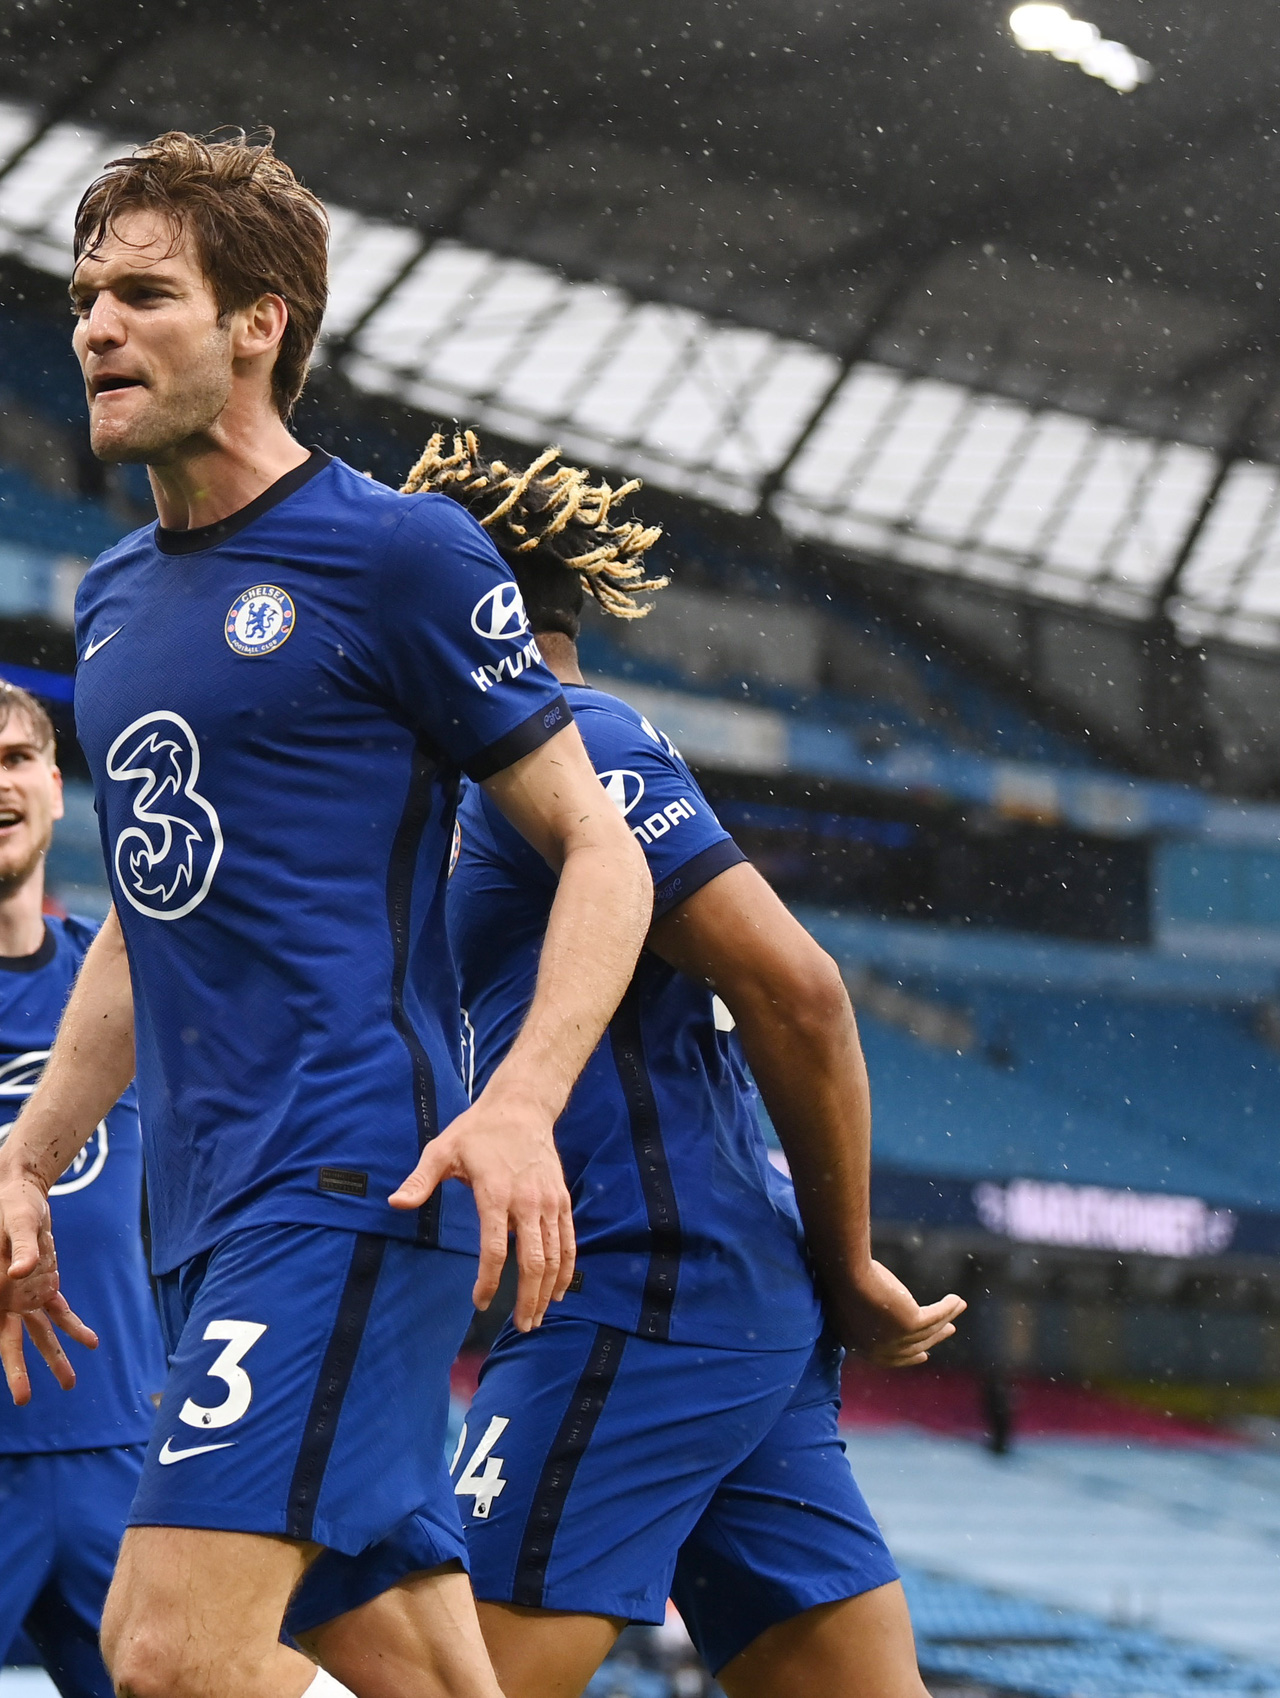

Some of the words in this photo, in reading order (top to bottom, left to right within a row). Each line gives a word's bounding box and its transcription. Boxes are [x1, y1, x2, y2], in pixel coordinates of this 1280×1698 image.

[241, 587, 286, 604] CHELSEA
[179, 1319, 268, 1429] 3
[449, 1415, 510, 1519] 4
